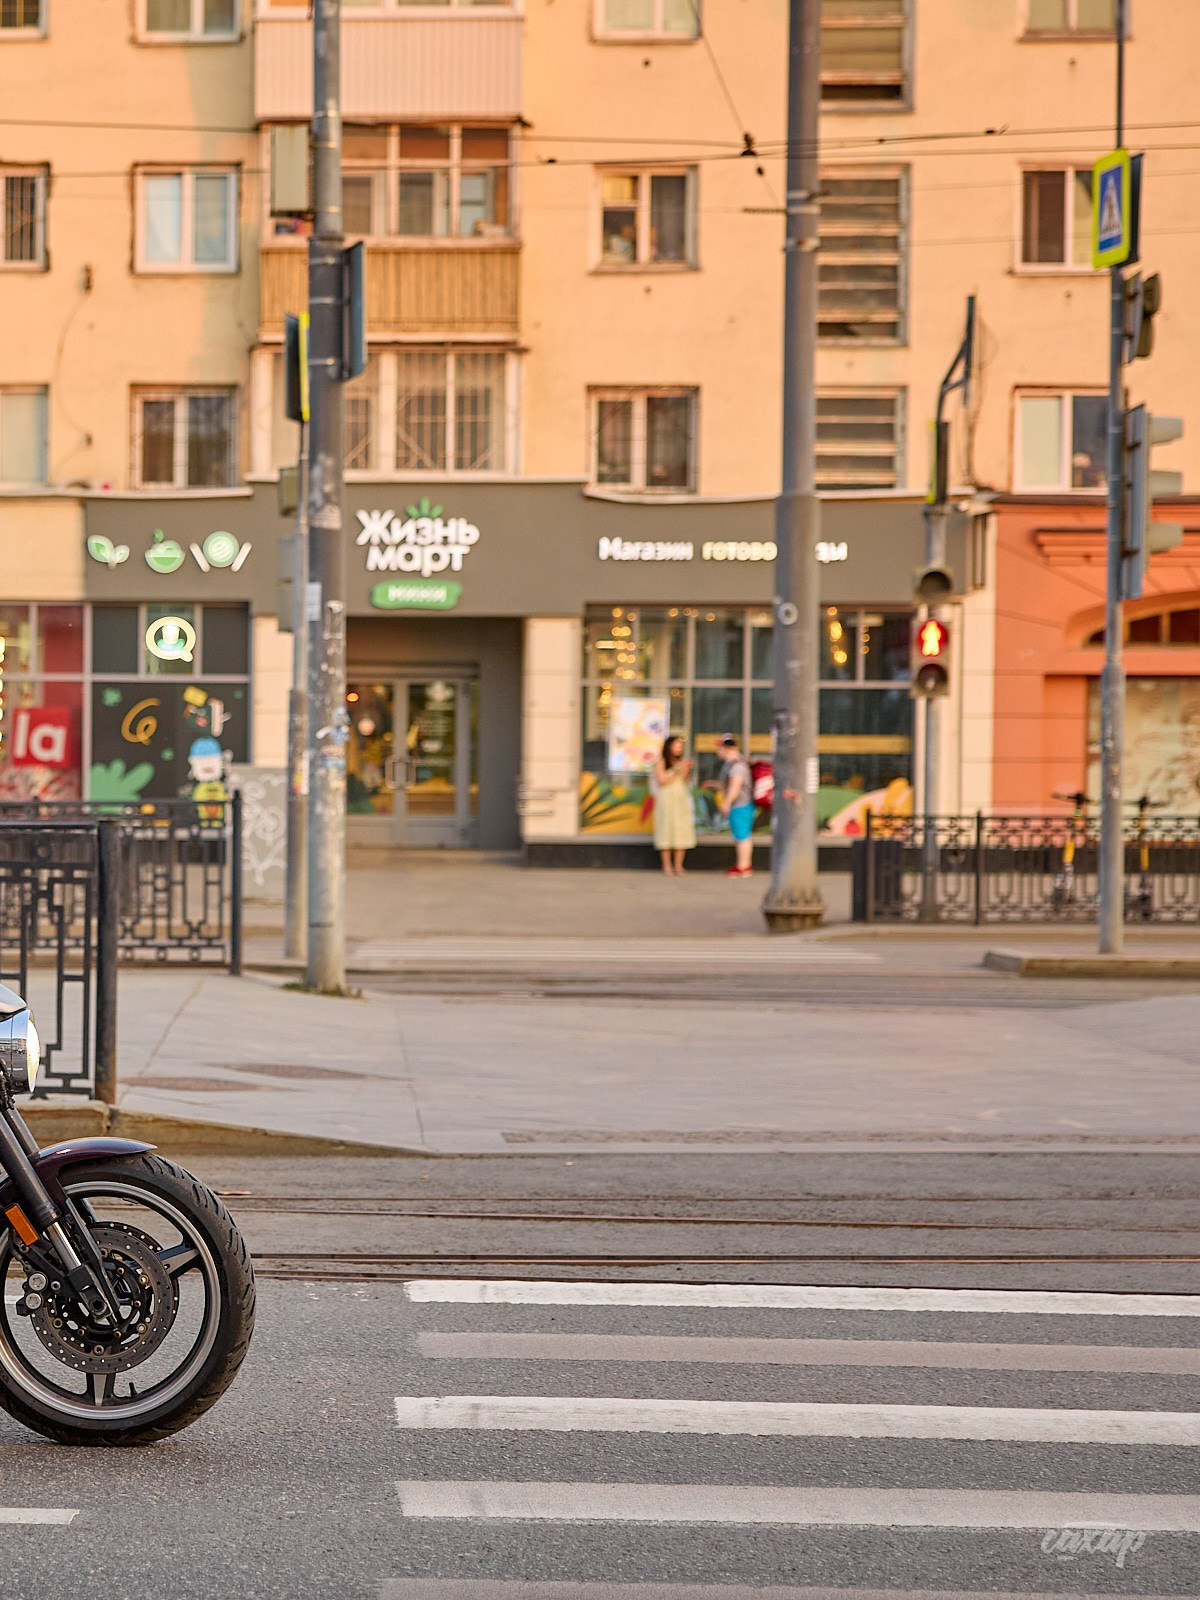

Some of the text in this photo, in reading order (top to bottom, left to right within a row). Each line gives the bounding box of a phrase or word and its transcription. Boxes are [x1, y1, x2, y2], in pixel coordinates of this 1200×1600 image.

[356, 509, 480, 545] Жизнь
[366, 545, 471, 577] март
[598, 536, 848, 564] Магазин готово ды
[13, 711, 67, 762] la
